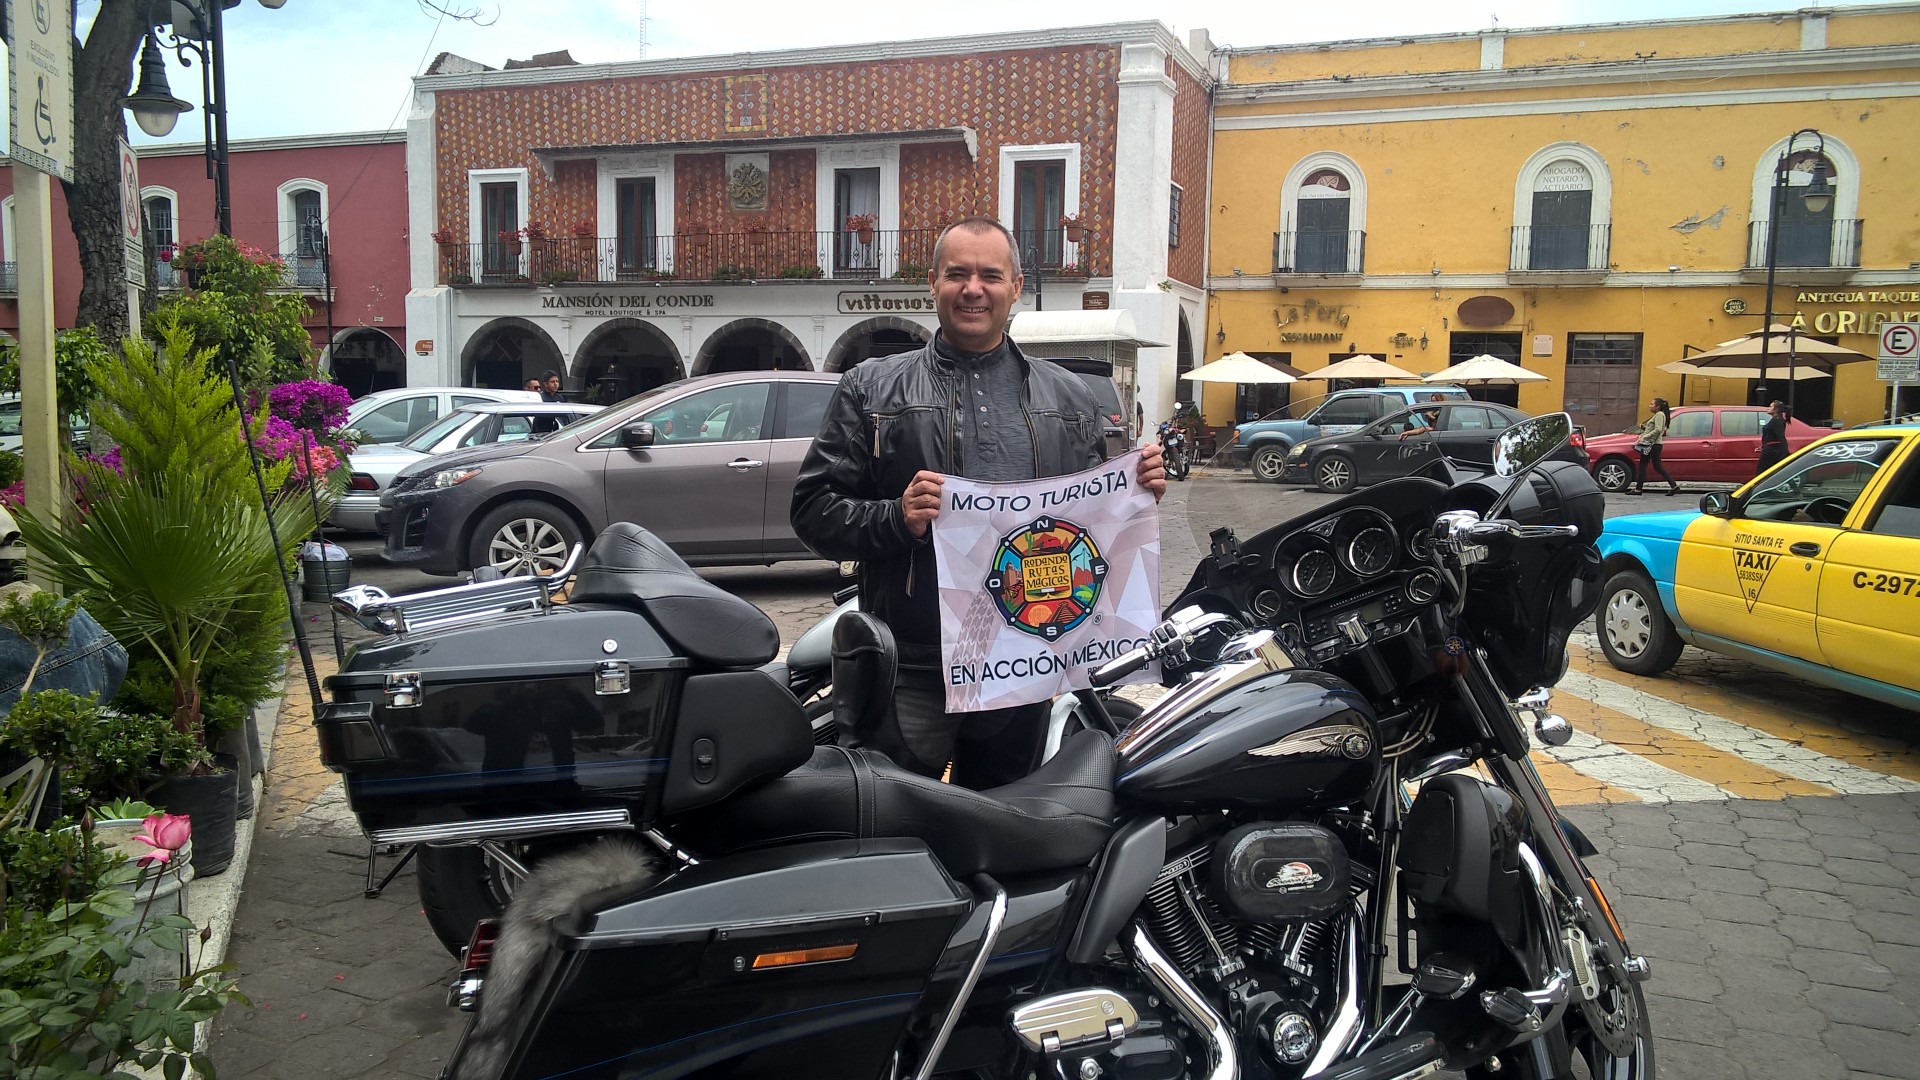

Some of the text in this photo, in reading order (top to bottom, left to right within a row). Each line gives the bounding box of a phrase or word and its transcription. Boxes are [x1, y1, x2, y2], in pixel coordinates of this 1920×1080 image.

[1543, 167, 1585, 175] ABOGADO
[1543, 175, 1579, 184] NOTARIO
[1543, 183, 1584, 191] ACTUARIO
[542, 292, 714, 308] MANSIÓN DEL CONDE
[1796, 291, 1865, 303] ANTIGUA
[1280, 333, 1343, 343] RESTAURANT
[1891, 331, 1908, 350] E
[951, 470, 1128, 512] MOTO TURISTA
[1036, 520, 1049, 529] N
[1735, 533, 1785, 549] SITIO SANTA FE
[1736, 551, 1772, 571] TAXI
[1095, 565, 1105, 575] E
[1748, 587, 1756, 599] 16
[1046, 626, 1057, 635] S
[951, 665, 976, 685] EN
[981, 650, 1068, 682] ACCIÓN
